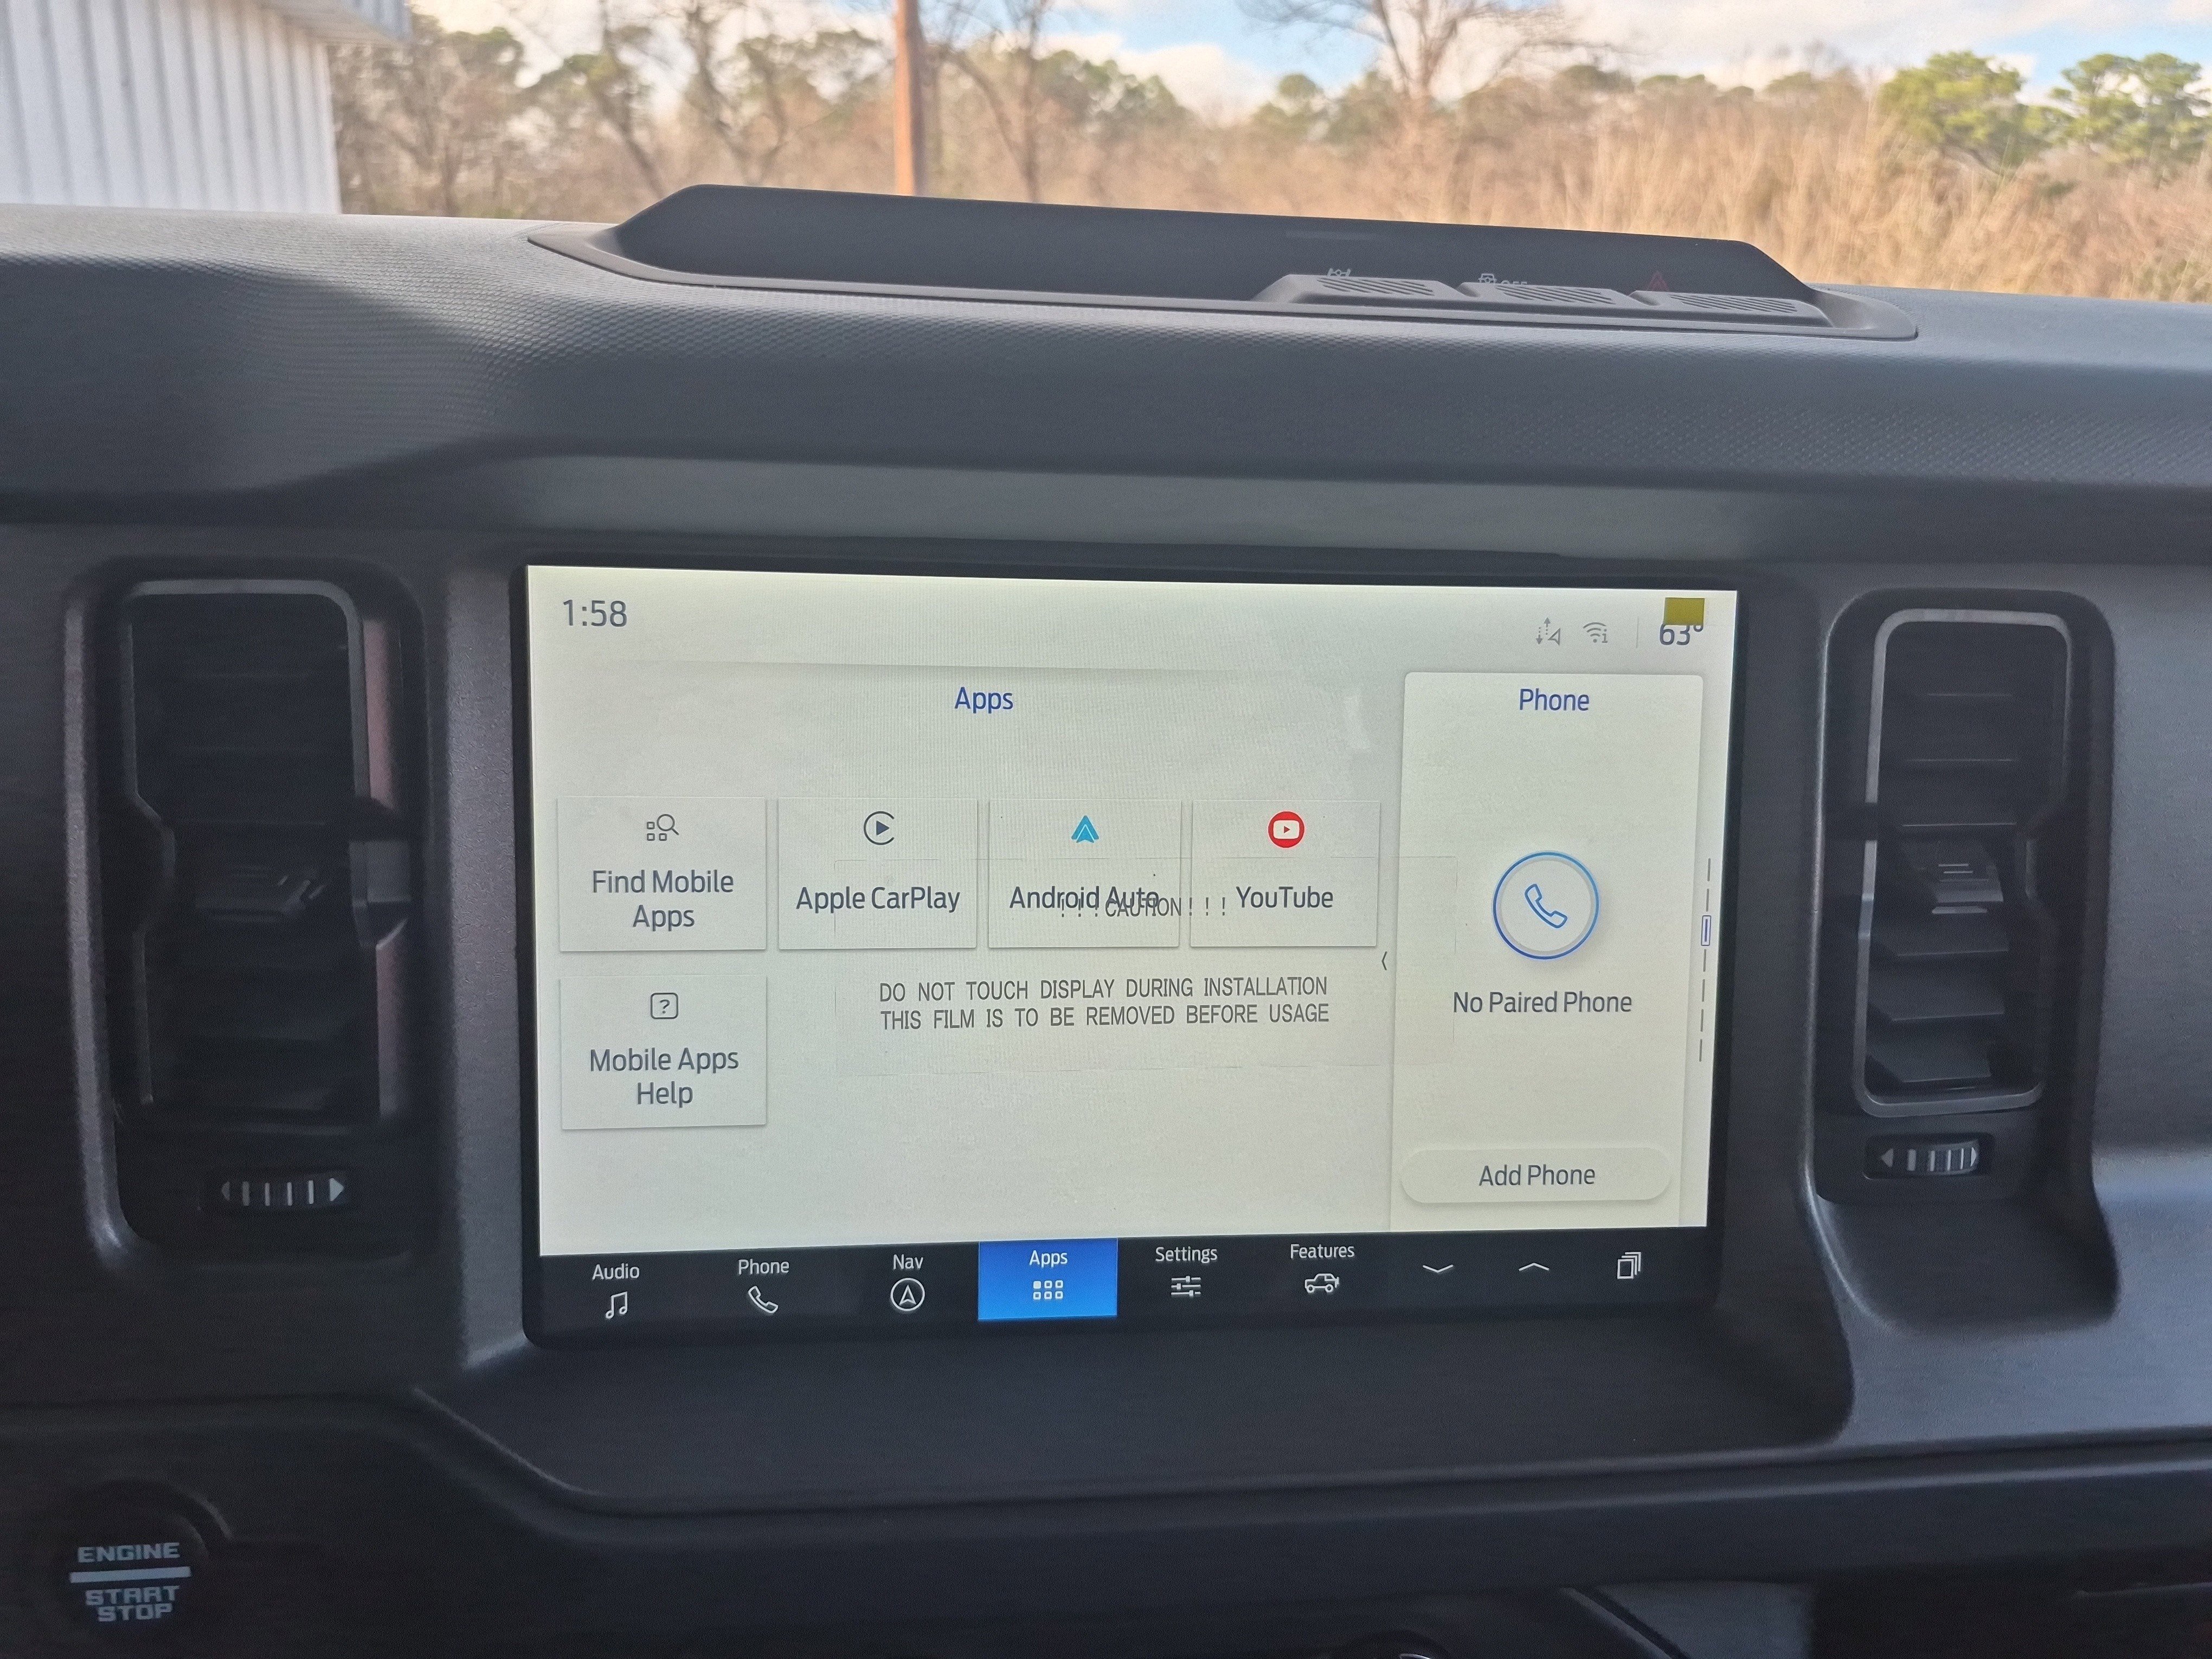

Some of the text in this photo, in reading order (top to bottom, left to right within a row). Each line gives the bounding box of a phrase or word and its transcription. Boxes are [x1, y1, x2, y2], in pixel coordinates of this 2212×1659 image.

[562, 599, 627, 627] 1:58
[954, 686, 1013, 713] Apps
[1519, 688, 1590, 711] Phone
[592, 870, 734, 893] Find Mobile
[796, 886, 961, 912] Apple CarPlay
[1009, 886, 1160, 909] Android Auto
[1236, 886, 1333, 909] YouTube
[633, 905, 695, 931] Apps
[880, 976, 1327, 1002] DO NOT TOUCH DISPLAY DURING INSTALLATION
[1453, 990, 1632, 1013] No Paired Phone
[880, 1003, 1329, 1030] THIS FILM IS TO BE REMOVED BEFORE USAGE
[590, 1049, 739, 1073] Mobile Apps
[636, 1082, 693, 1108] Help
[1478, 1164, 1596, 1186] Add Phone
[892, 1254, 924, 1270] Nav
[1030, 1249, 1068, 1268] Apps
[1155, 1246, 1218, 1264] Settings
[1290, 1243, 1355, 1259] Features
[592, 1263, 640, 1280] Audio
[738, 1258, 790, 1275] Phone
[78, 1542, 181, 1563] ENGINE
[85, 1585, 179, 1606] START
[98, 1603, 173, 1622] STOP
